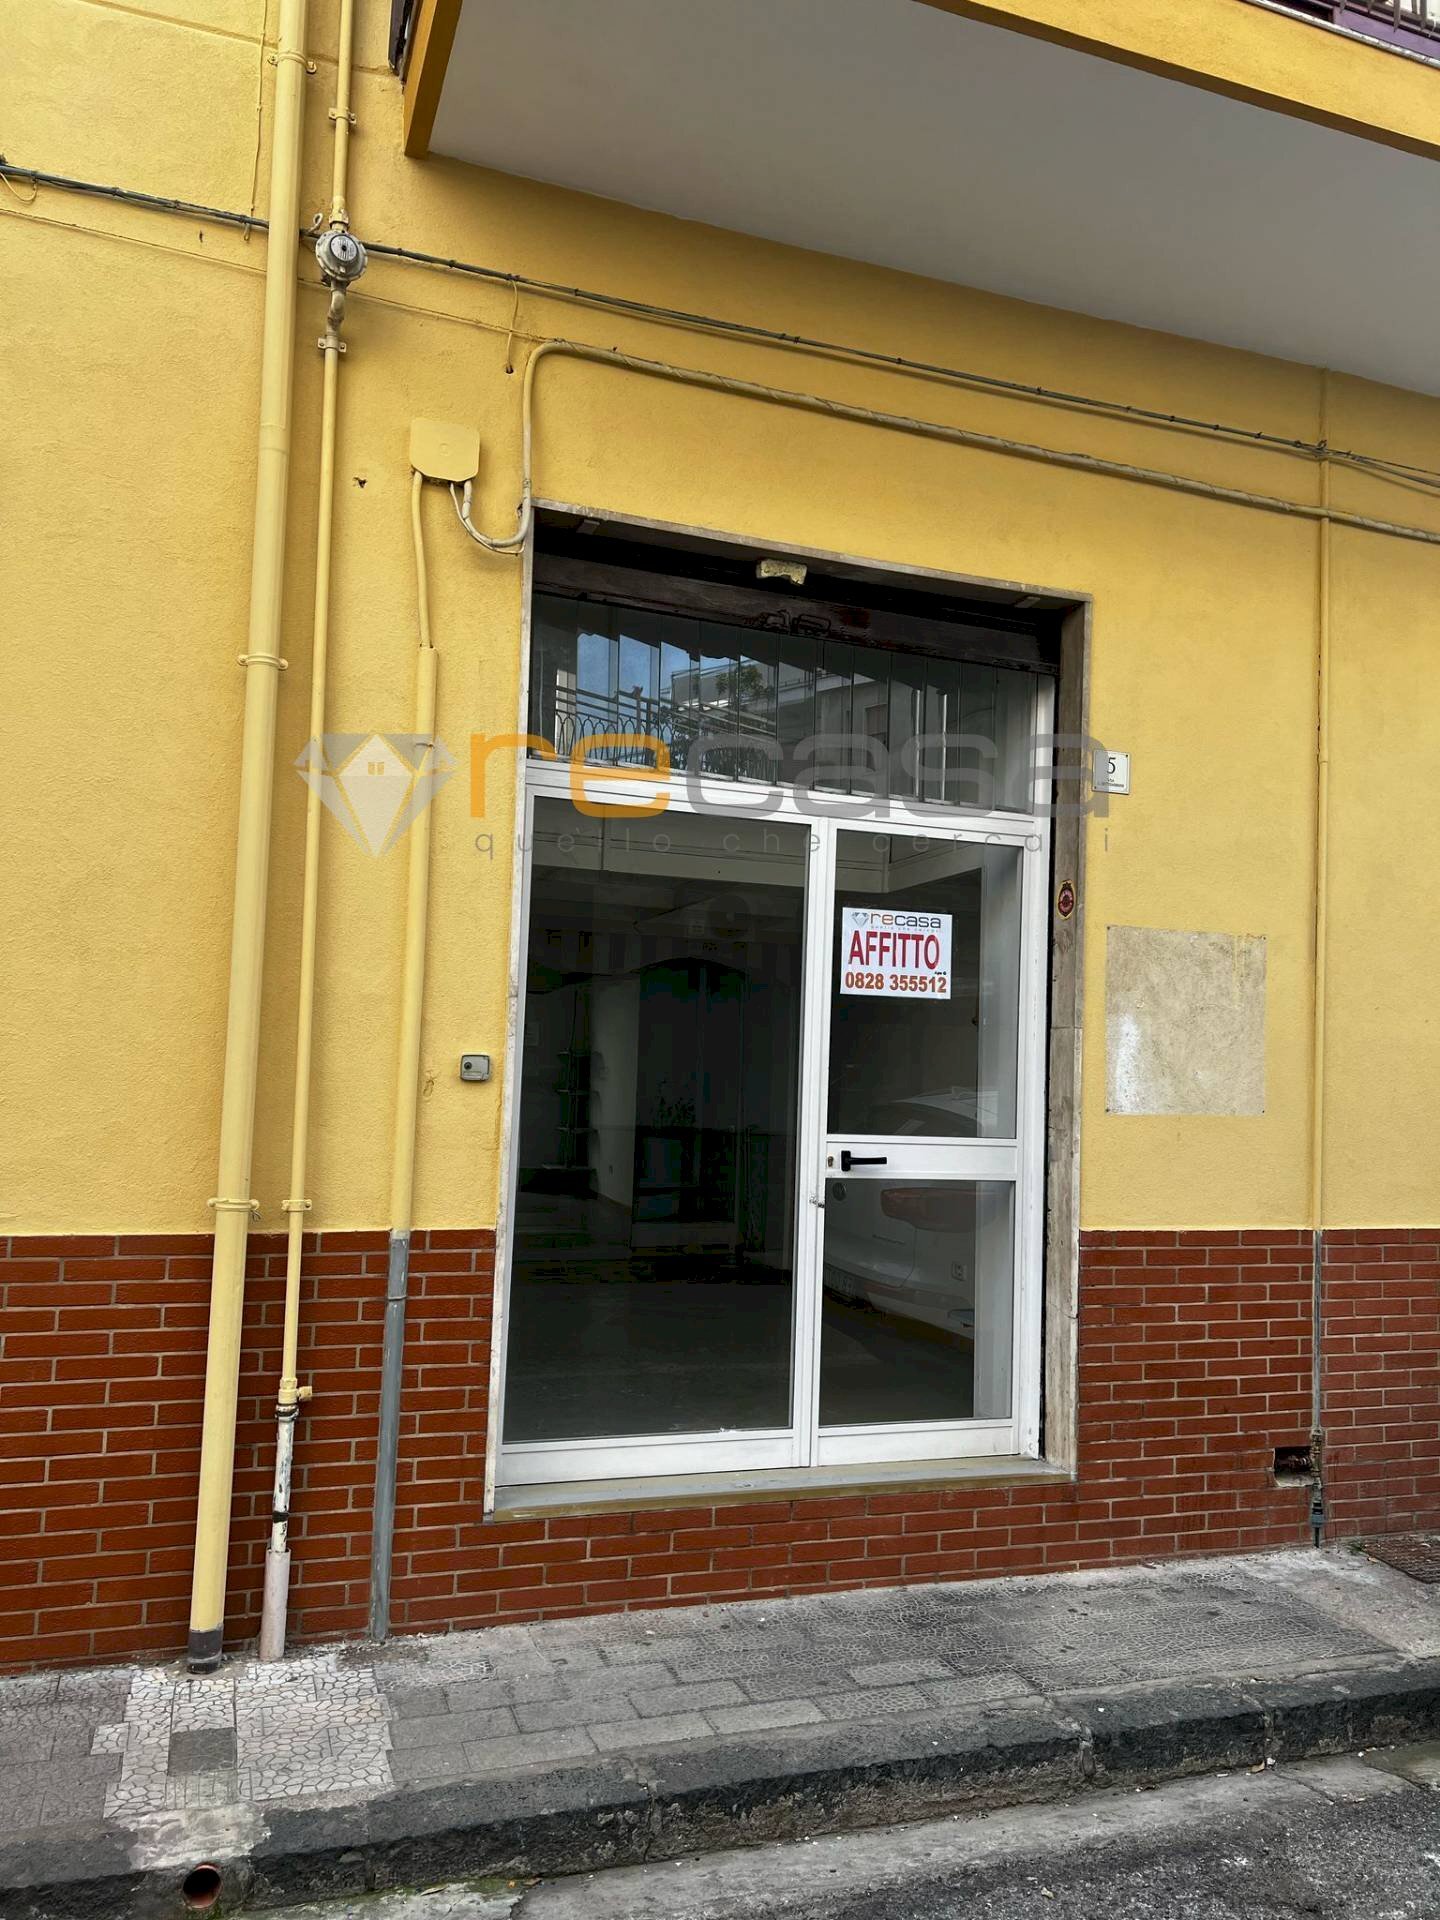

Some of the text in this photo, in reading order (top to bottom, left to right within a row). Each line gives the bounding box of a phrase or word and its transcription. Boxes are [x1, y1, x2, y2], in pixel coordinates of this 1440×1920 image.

[1106, 756, 1116, 774] 5
[870, 913, 941, 928] recasa
[848, 930, 940, 970] AFFITTO
[845, 972, 947, 993] 0828 355512
